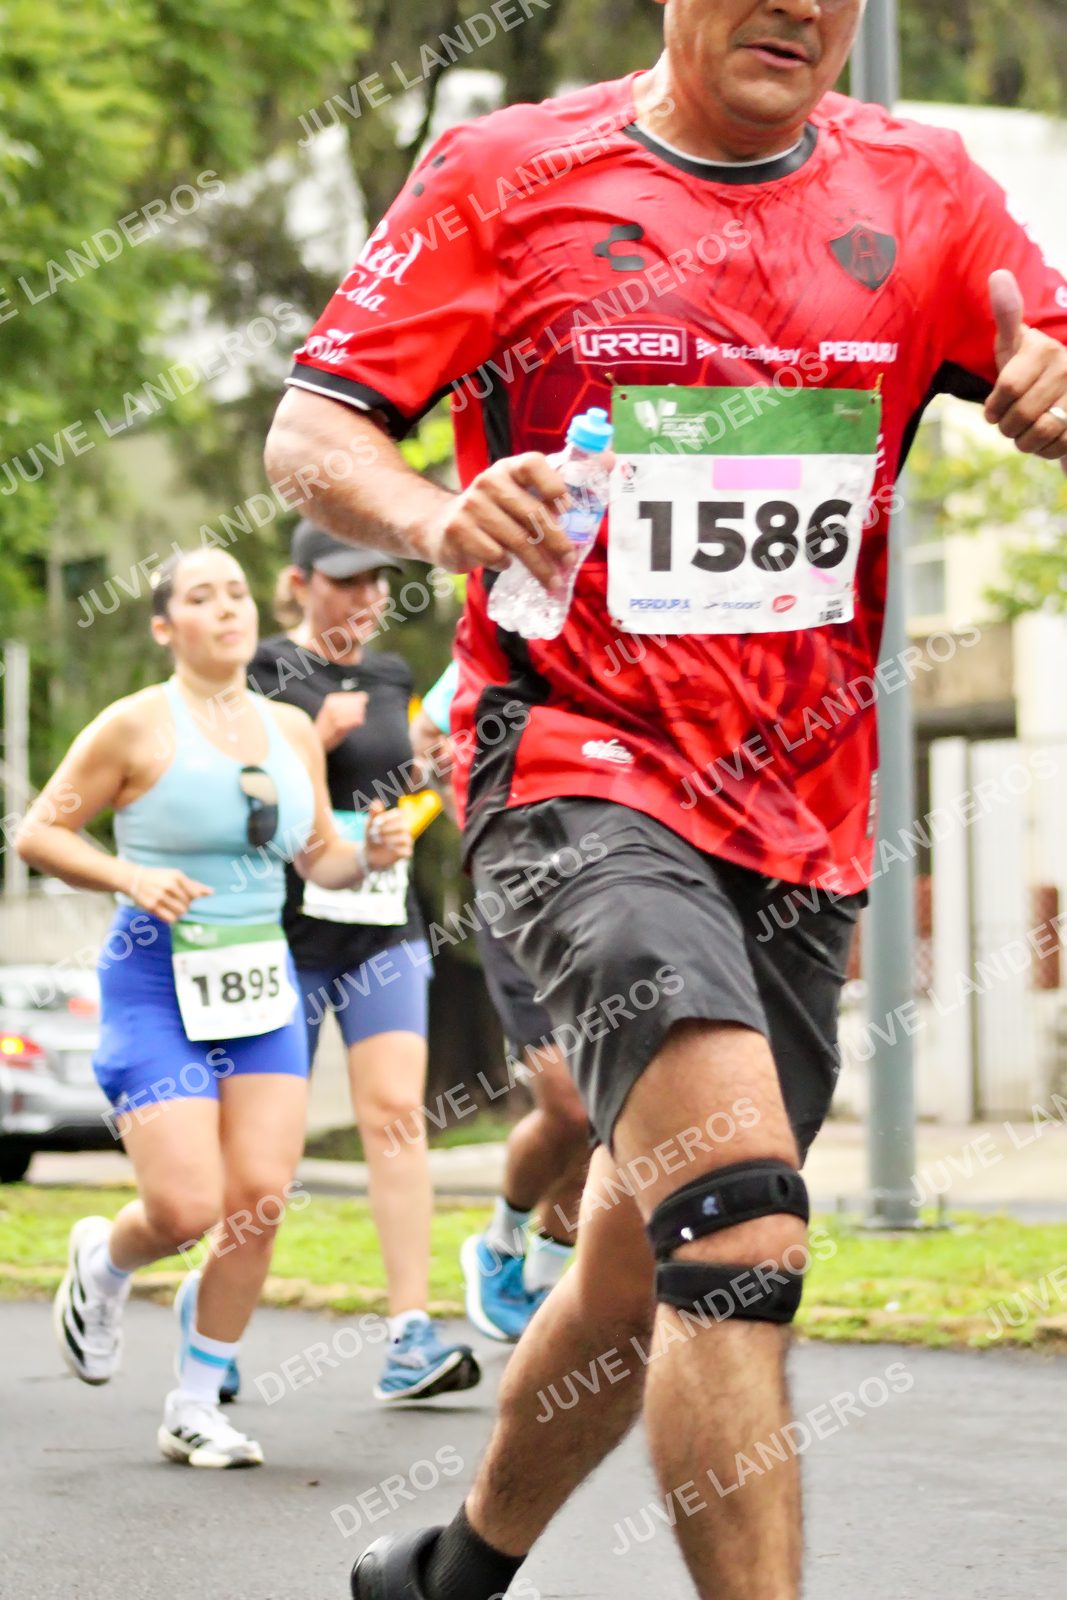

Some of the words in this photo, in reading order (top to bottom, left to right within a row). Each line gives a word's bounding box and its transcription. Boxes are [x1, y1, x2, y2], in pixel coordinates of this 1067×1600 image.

[335, 270, 387, 312] Cola
[579, 332, 680, 358] URREA
[720, 343, 801, 365] Totalplay
[637, 498, 852, 573] 1586
[191, 964, 281, 1007] 1895
